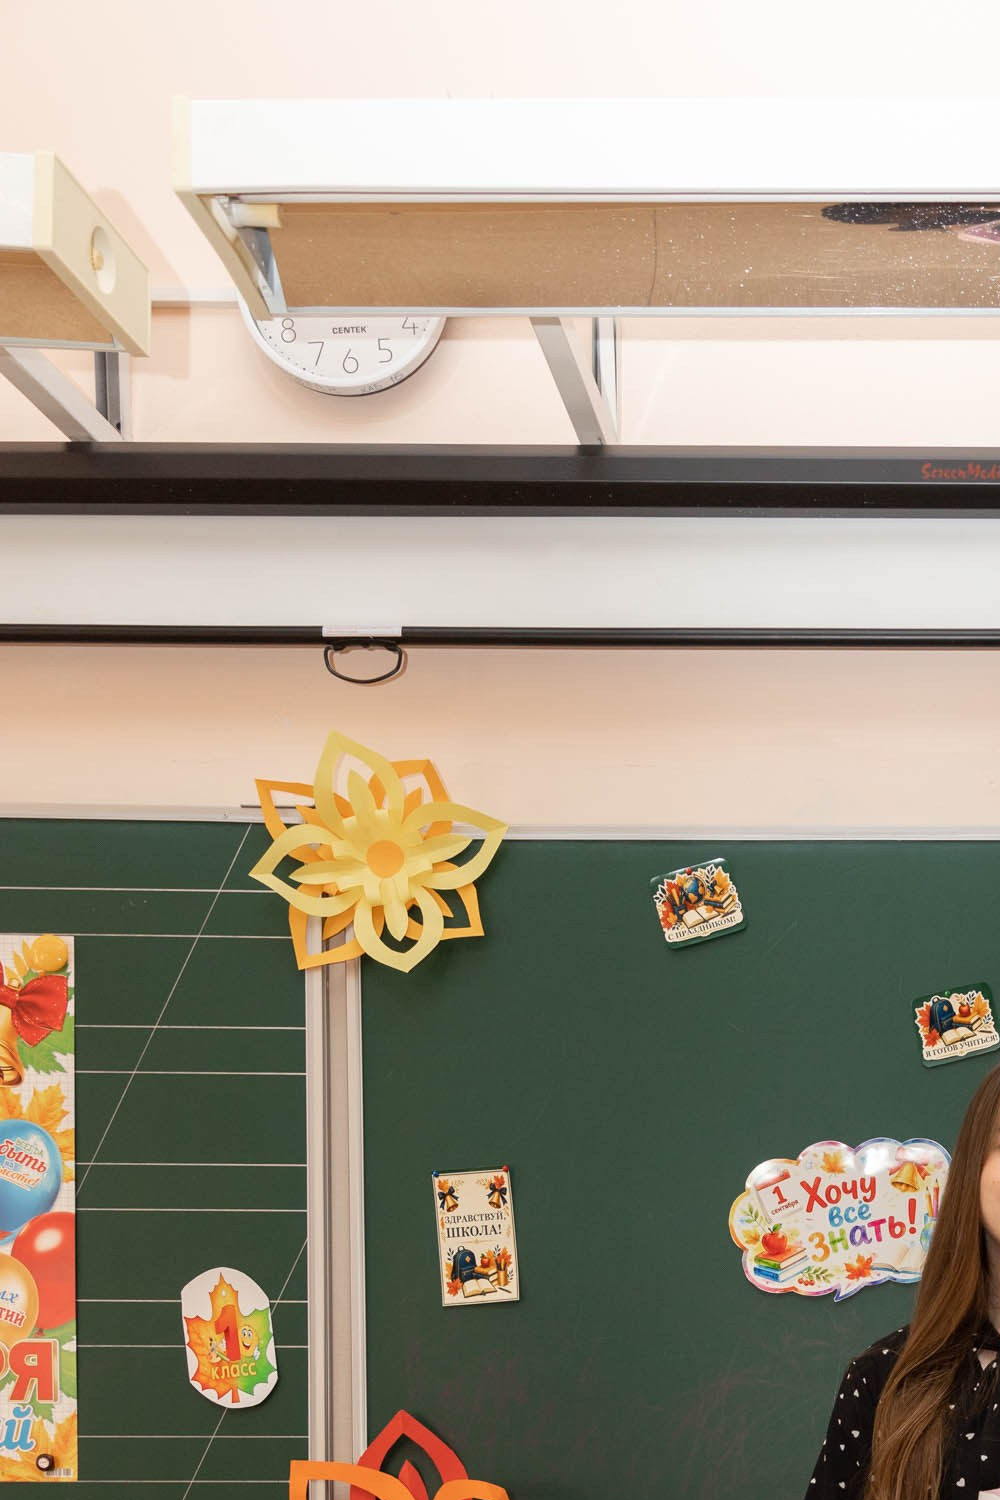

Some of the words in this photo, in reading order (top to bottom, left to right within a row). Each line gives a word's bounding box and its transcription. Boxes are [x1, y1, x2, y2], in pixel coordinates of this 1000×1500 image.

[281, 318, 296, 343] 8
[402, 317, 419, 335] 4
[308, 341, 324, 366] 7
[342, 348, 359, 373] 6
[377, 338, 393, 363] 5
[933, 1045, 959, 1057] ГОТОВ
[772, 1186, 788, 1204] 1
[800, 1176, 876, 1213] Хочу
[446, 1223, 502, 1239] ШКОЛА!
[214, 1304, 241, 1361] 1
[211, 1362, 257, 1380] класс
